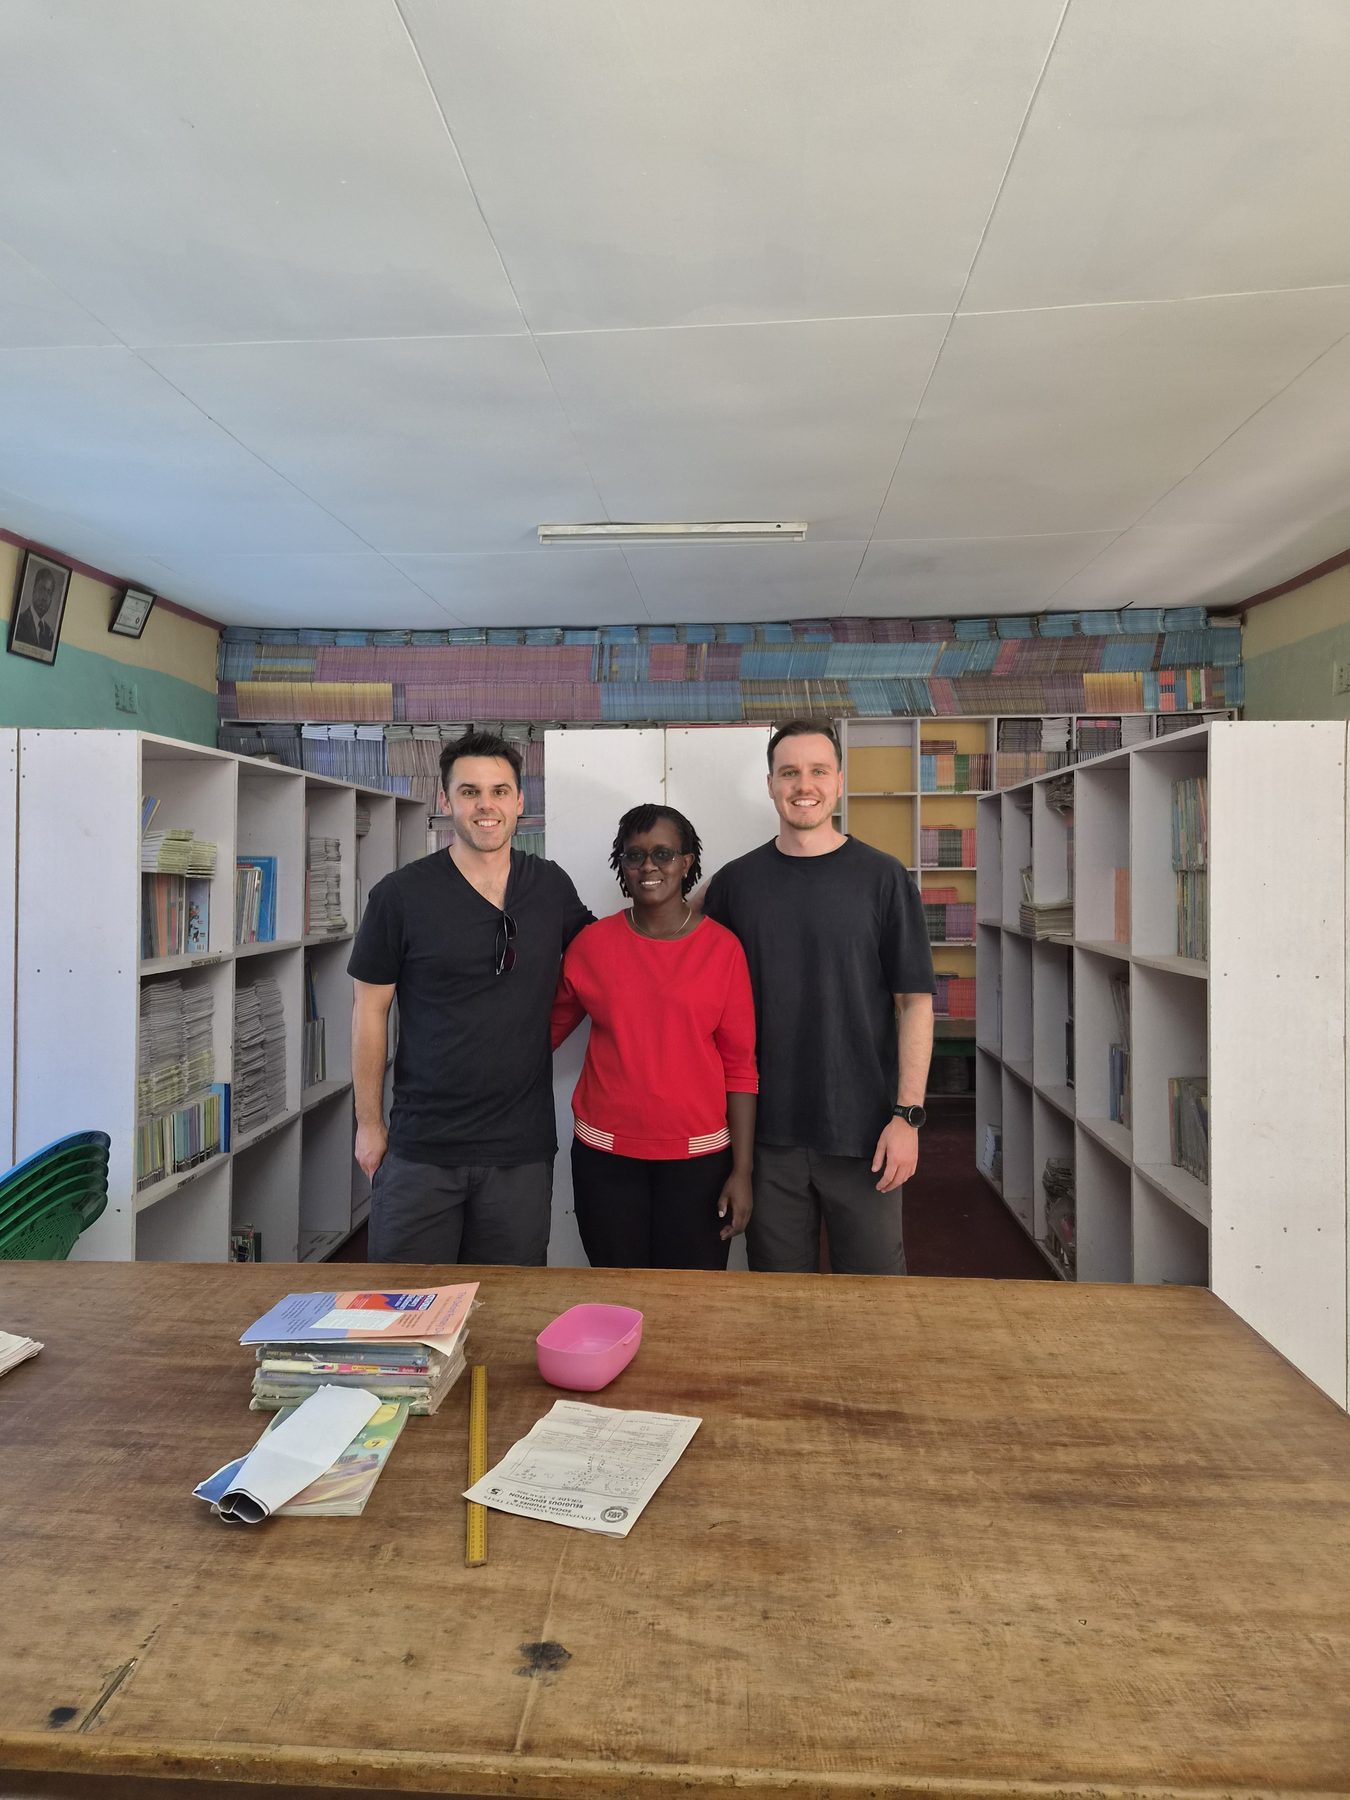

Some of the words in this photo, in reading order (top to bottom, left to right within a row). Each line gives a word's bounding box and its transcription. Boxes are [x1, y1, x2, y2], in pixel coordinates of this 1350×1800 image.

[490, 1488, 501, 1496] 5
[508, 1492, 548, 1504] EDUCATION
[557, 1496, 582, 1504] GRADE
[519, 1500, 547, 1509] STUDIES
[548, 1500, 584, 1509] RELIGIOUS
[549, 1506, 572, 1514] SOCIAL
[550, 1511, 596, 1522] CONTINUOUS
